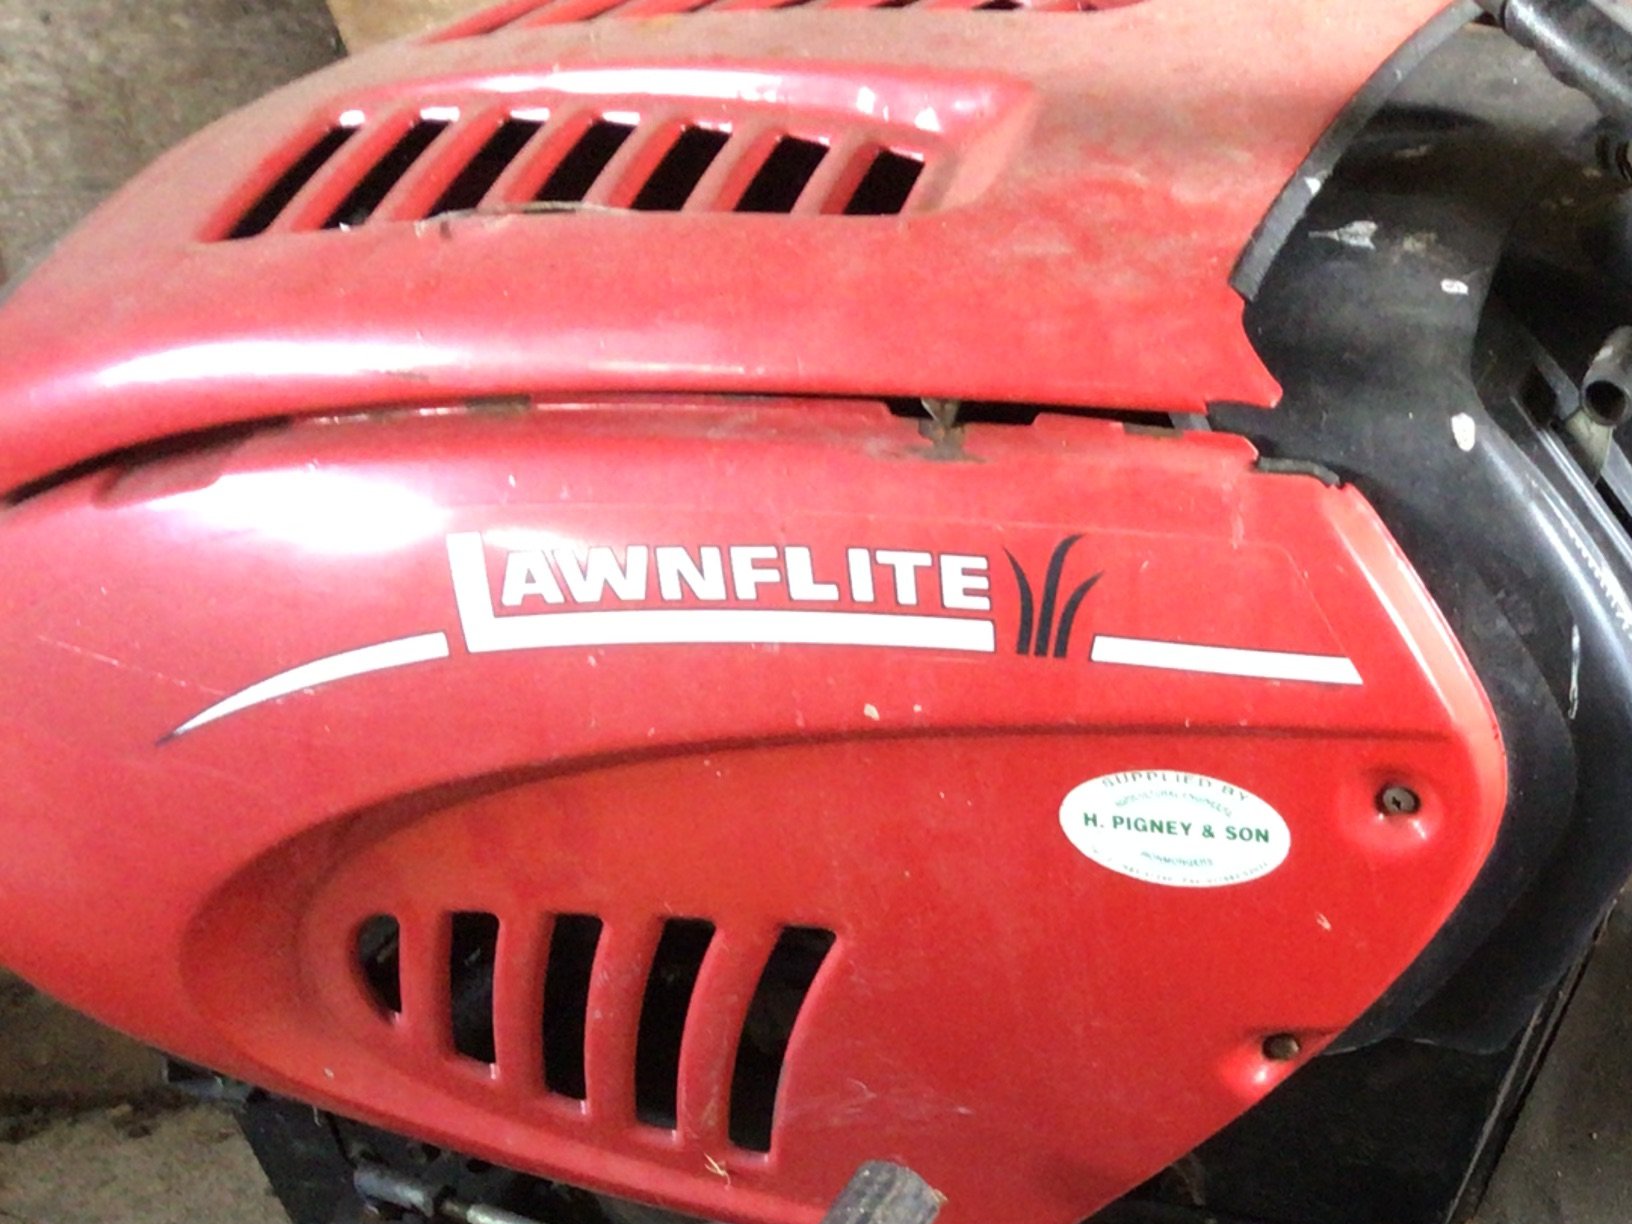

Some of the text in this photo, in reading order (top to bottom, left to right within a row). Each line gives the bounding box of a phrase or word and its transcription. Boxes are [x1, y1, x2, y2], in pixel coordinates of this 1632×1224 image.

[446, 531, 995, 653] LAWNFLITE
[1083, 812, 1270, 843] H. PIGNEY & SON
